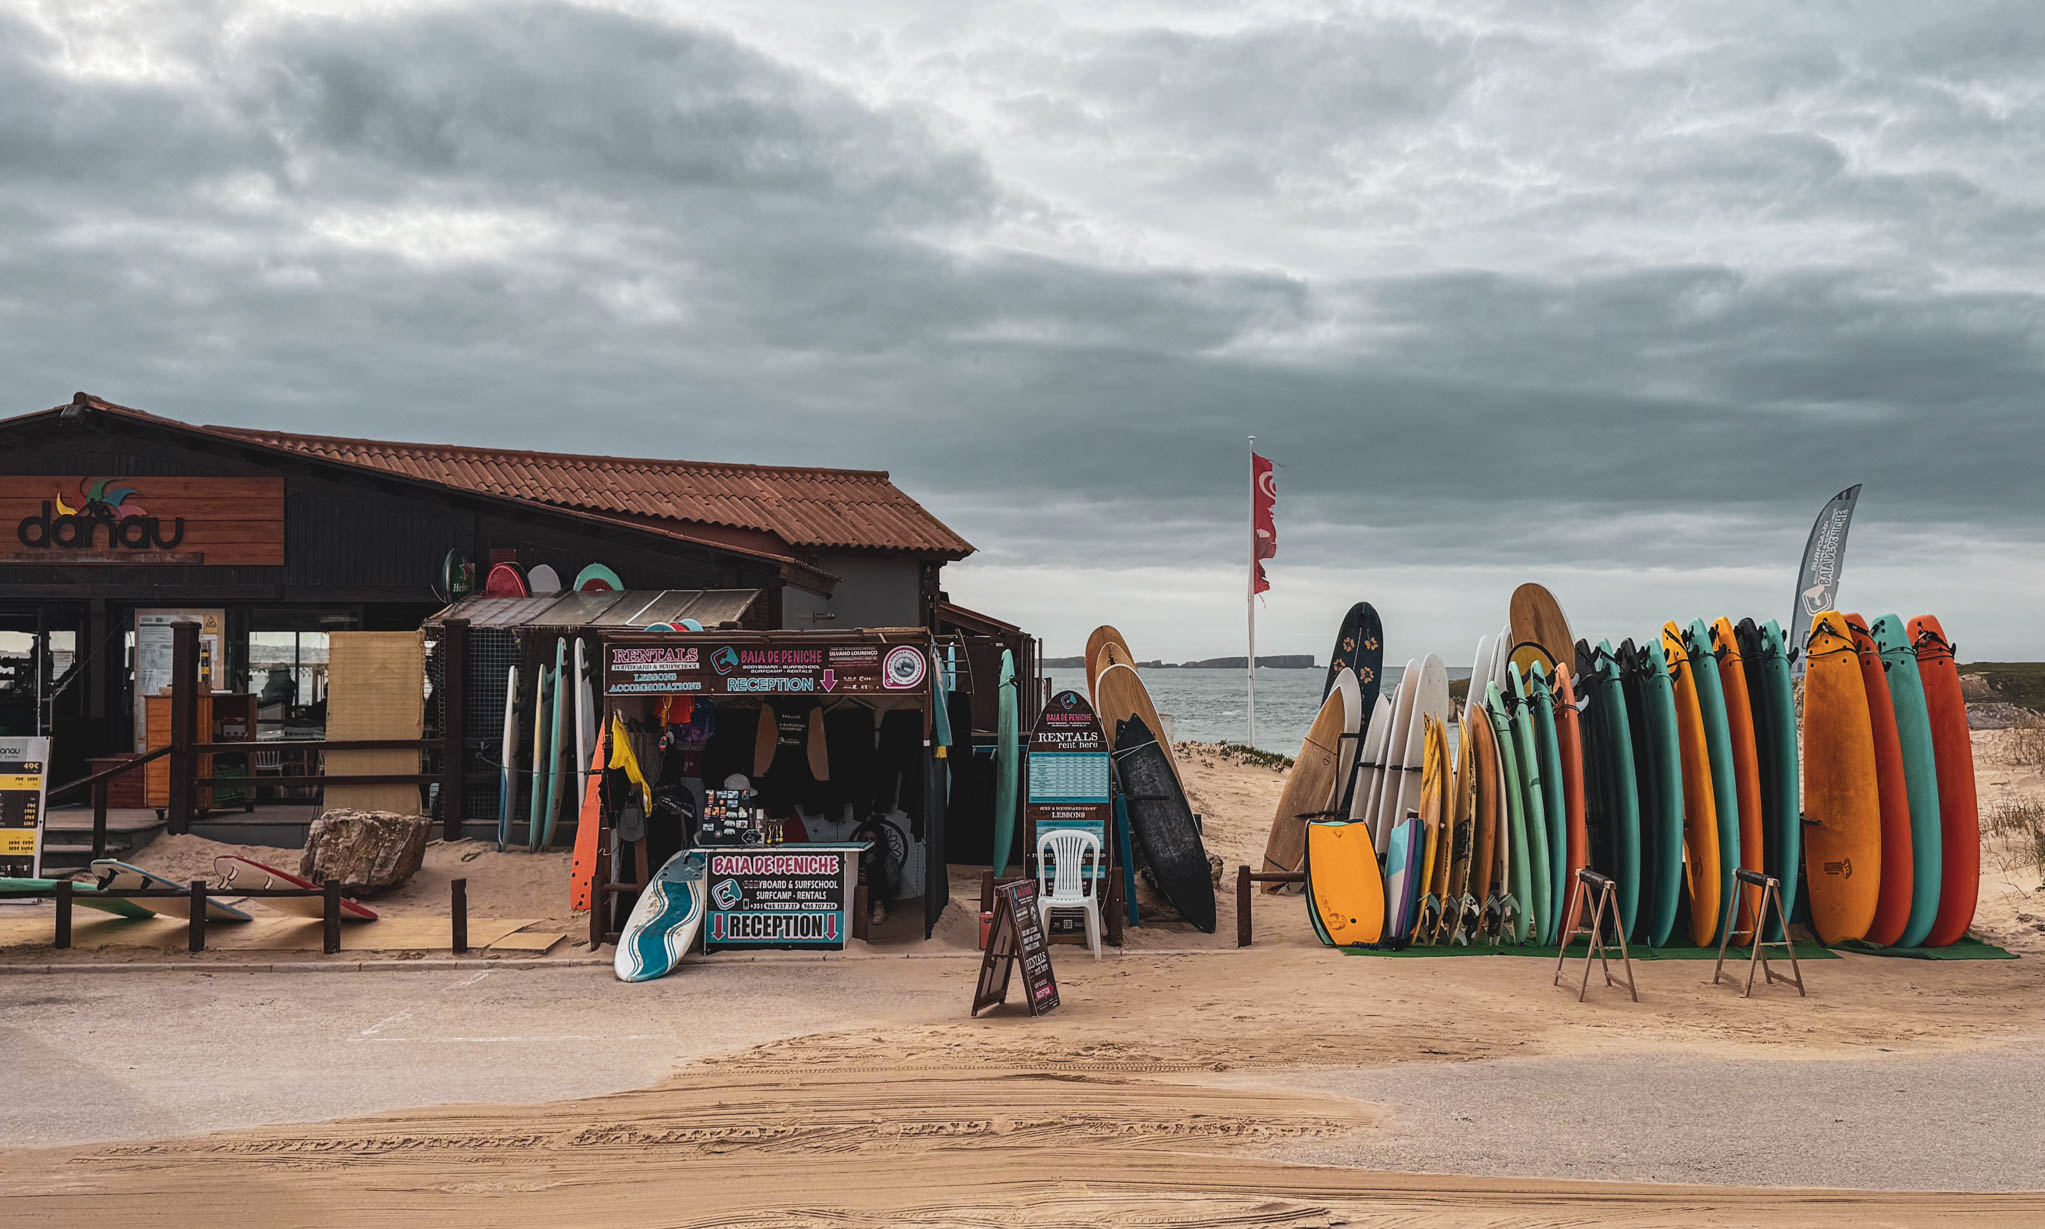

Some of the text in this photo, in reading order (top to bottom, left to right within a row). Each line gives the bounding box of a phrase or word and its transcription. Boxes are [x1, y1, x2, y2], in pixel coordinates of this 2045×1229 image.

[17, 500, 184, 549] danau
[612, 648, 699, 663] RENTALS
[741, 650, 766, 664] BAIA
[767, 650, 780, 663] DE
[781, 650, 823, 663] PENICHE
[633, 672, 677, 682] LESSONS
[609, 681, 701, 693] ACCOMMODATIONS
[727, 677, 814, 692] RECEPTION
[1038, 732, 1098, 742] RENTALS
[712, 856, 840, 875] BAIA DE PENICHE
[794, 880, 838, 889] SURFSCHOOL
[756, 891, 792, 900] SURFCAMP
[797, 891, 827, 900] RENTALS
[728, 914, 824, 939] RECEPTION
